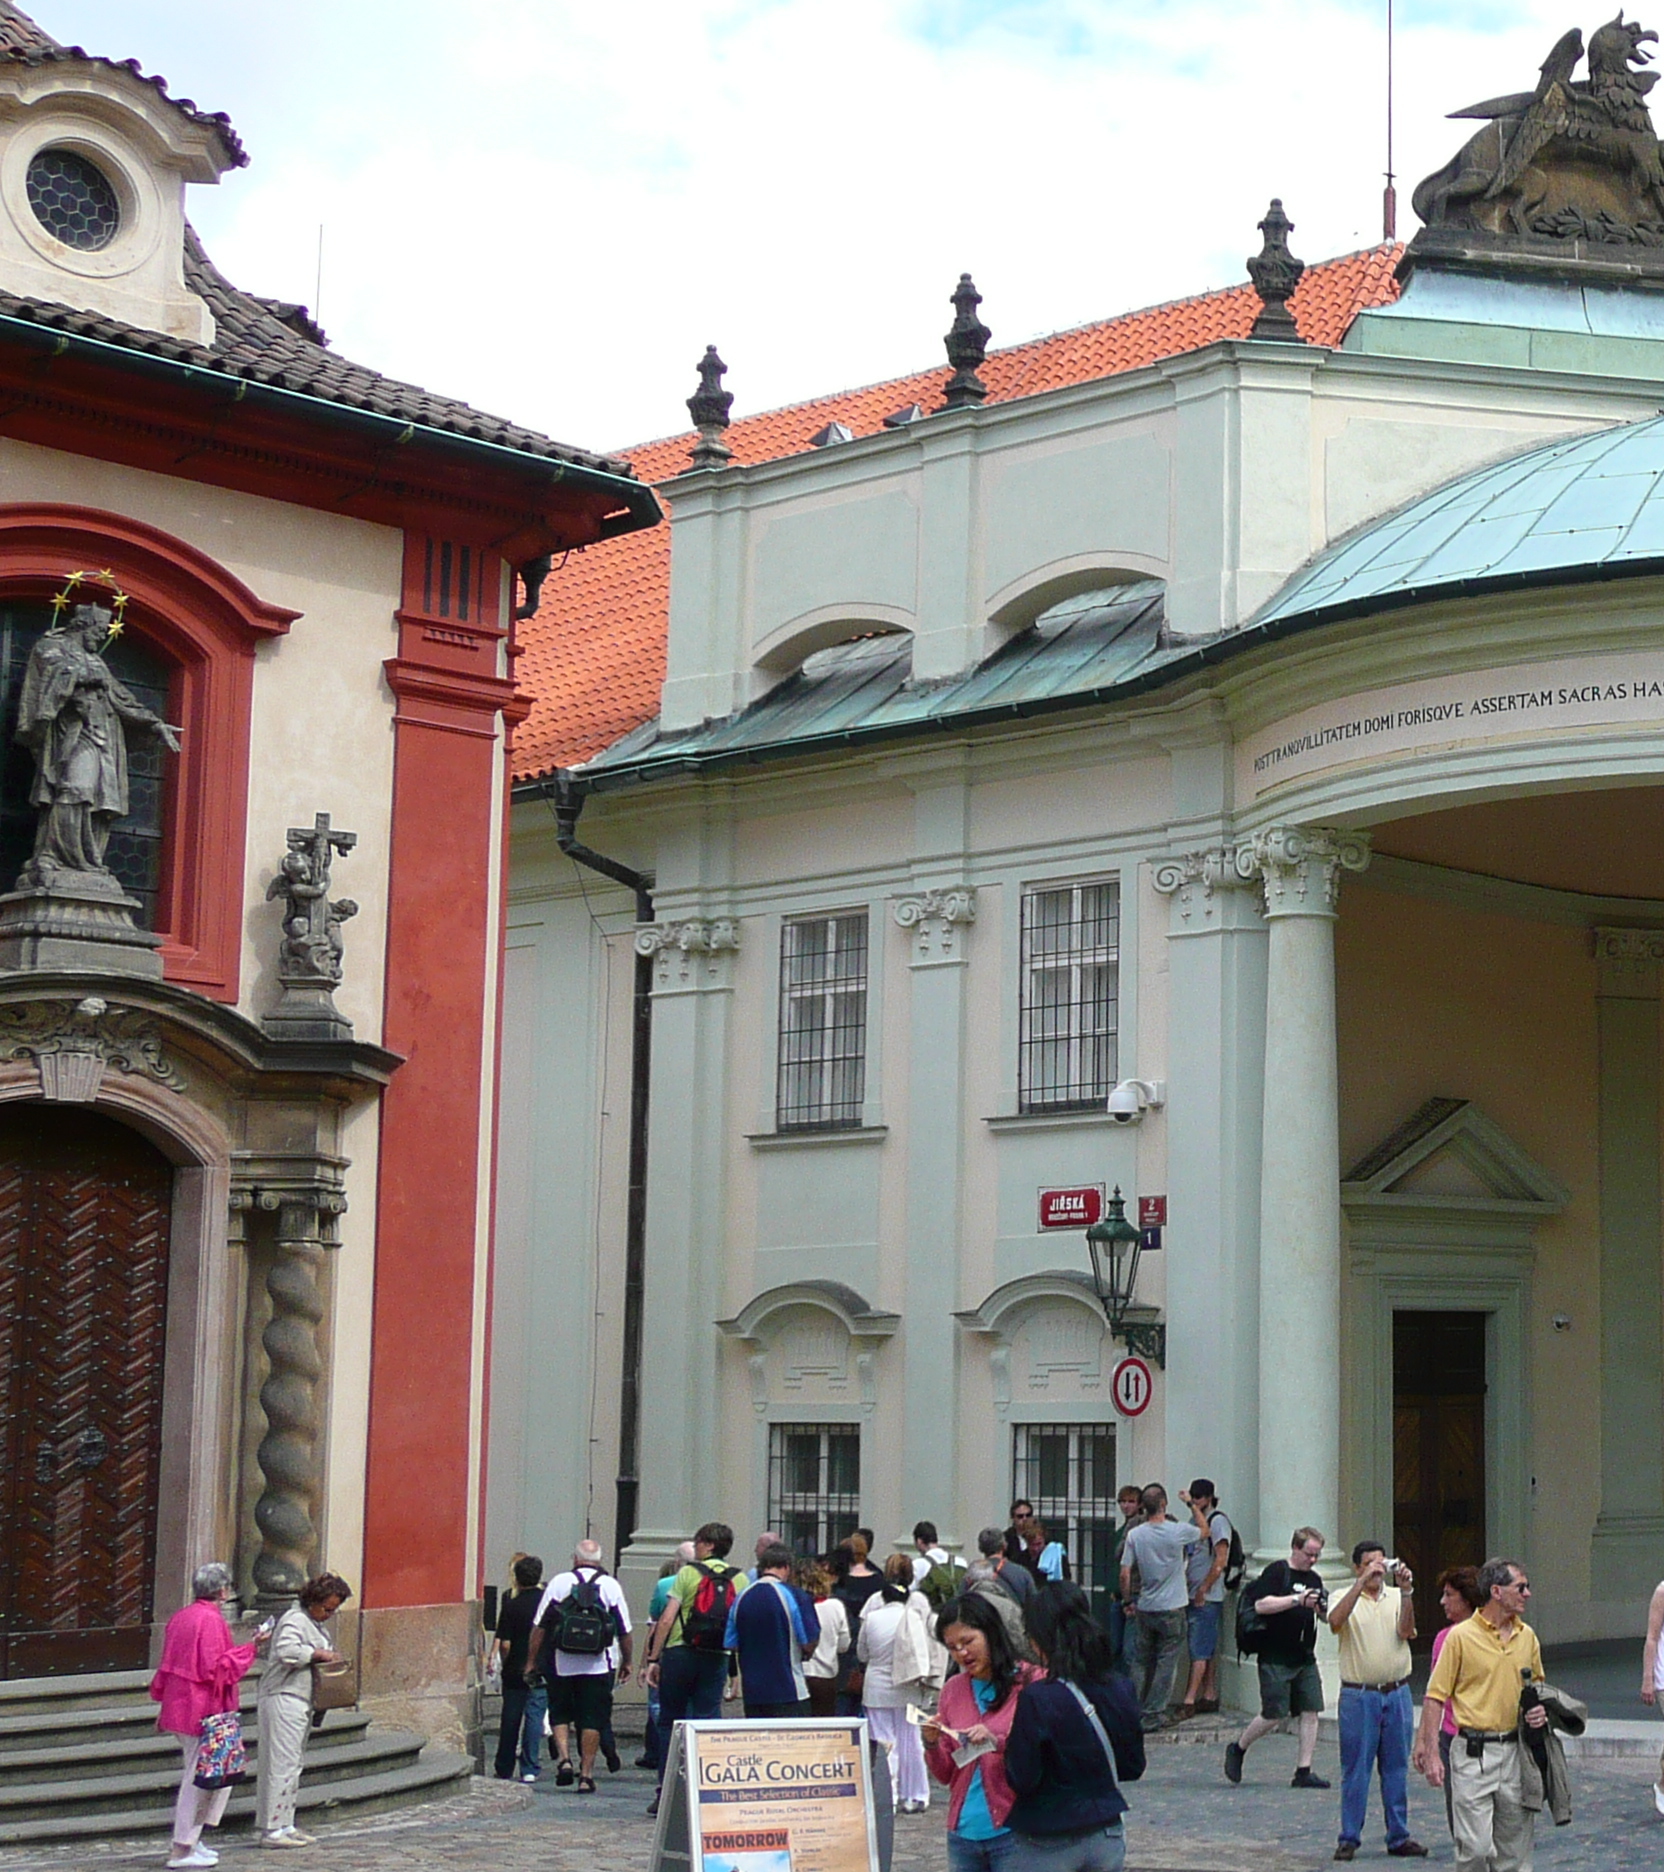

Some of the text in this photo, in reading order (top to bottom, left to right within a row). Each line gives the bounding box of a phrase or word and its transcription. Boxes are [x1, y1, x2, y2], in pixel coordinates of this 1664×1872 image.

[1364, 712, 1395, 735] DOMI
[1398, 703, 1464, 728] FORISQVE
[1470, 690, 1553, 716] ASSERTAM
[1558, 684, 1627, 705] SACRAS
[1050, 1194, 1085, 1211] JIŘSKÁ
[1148, 1199, 1155, 1210] 2
[1147, 1232, 1152, 1245] 1
[727, 1753, 763, 1767] Castle
[720, 1790, 736, 1802] The
[738, 1790, 757, 1801] Best
[802, 1786, 811, 1797] of
[703, 1832, 788, 1849] TOMORROW
